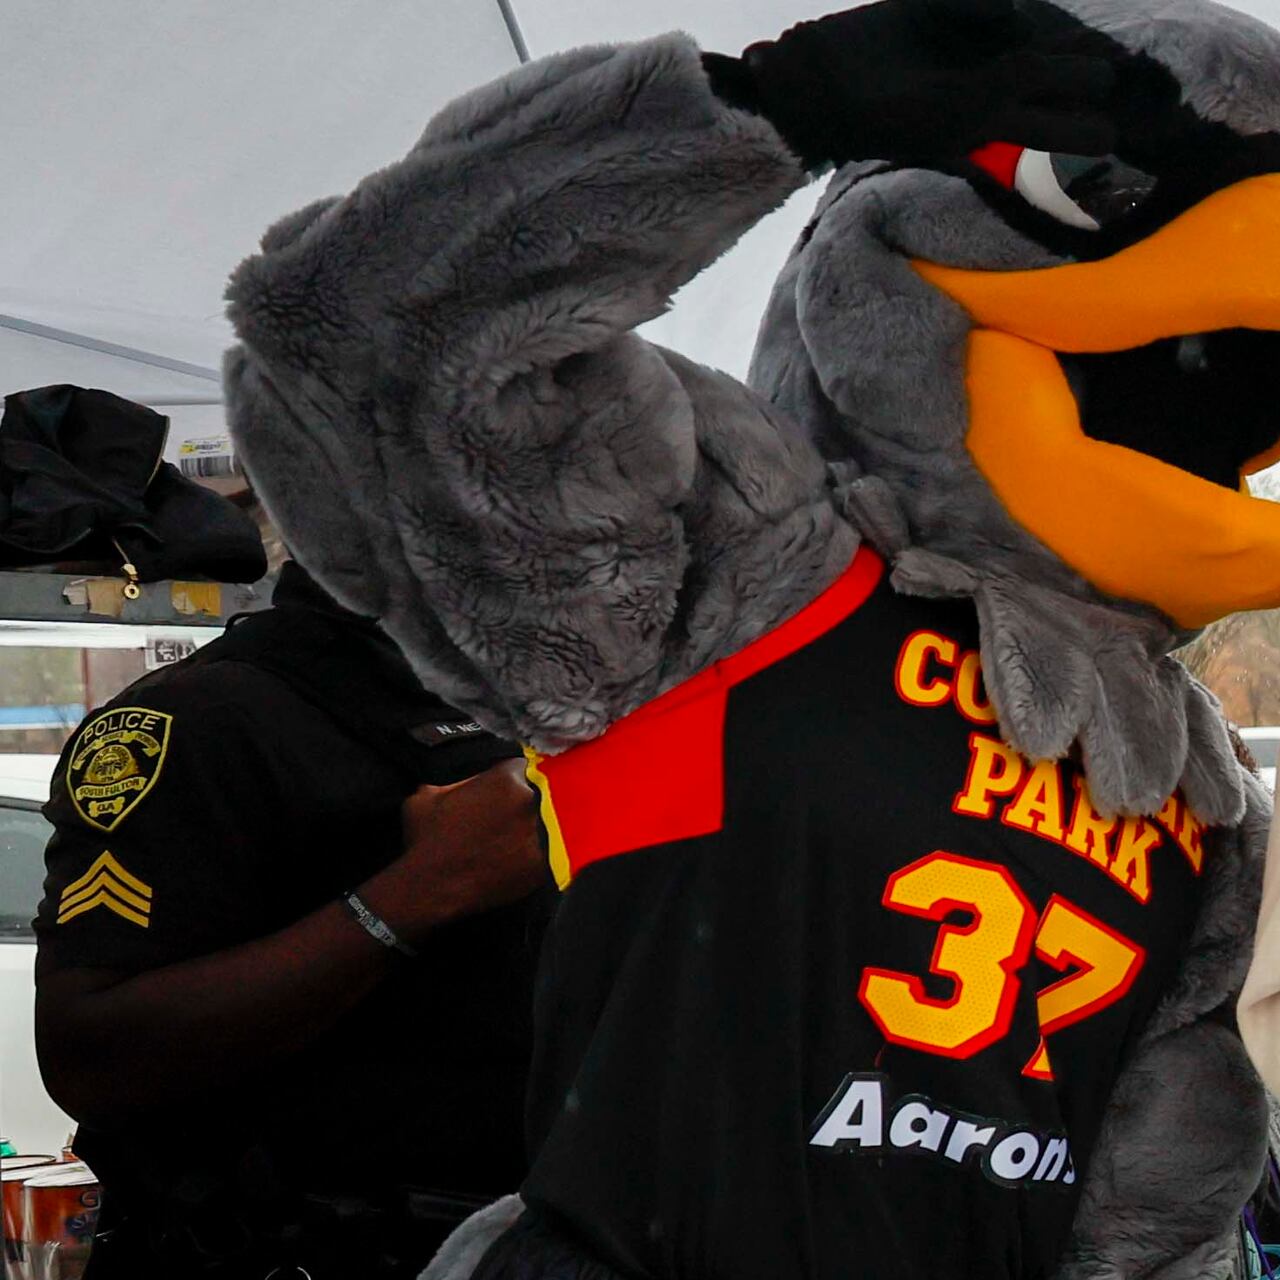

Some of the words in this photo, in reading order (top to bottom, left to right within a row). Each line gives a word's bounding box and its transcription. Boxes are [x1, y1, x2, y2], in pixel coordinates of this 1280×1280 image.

[83, 712, 161, 744] POLICE
[104, 778, 141, 795] FULTON
[952, 732, 1163, 905] PARK
[857, 850, 1146, 1082] 37
